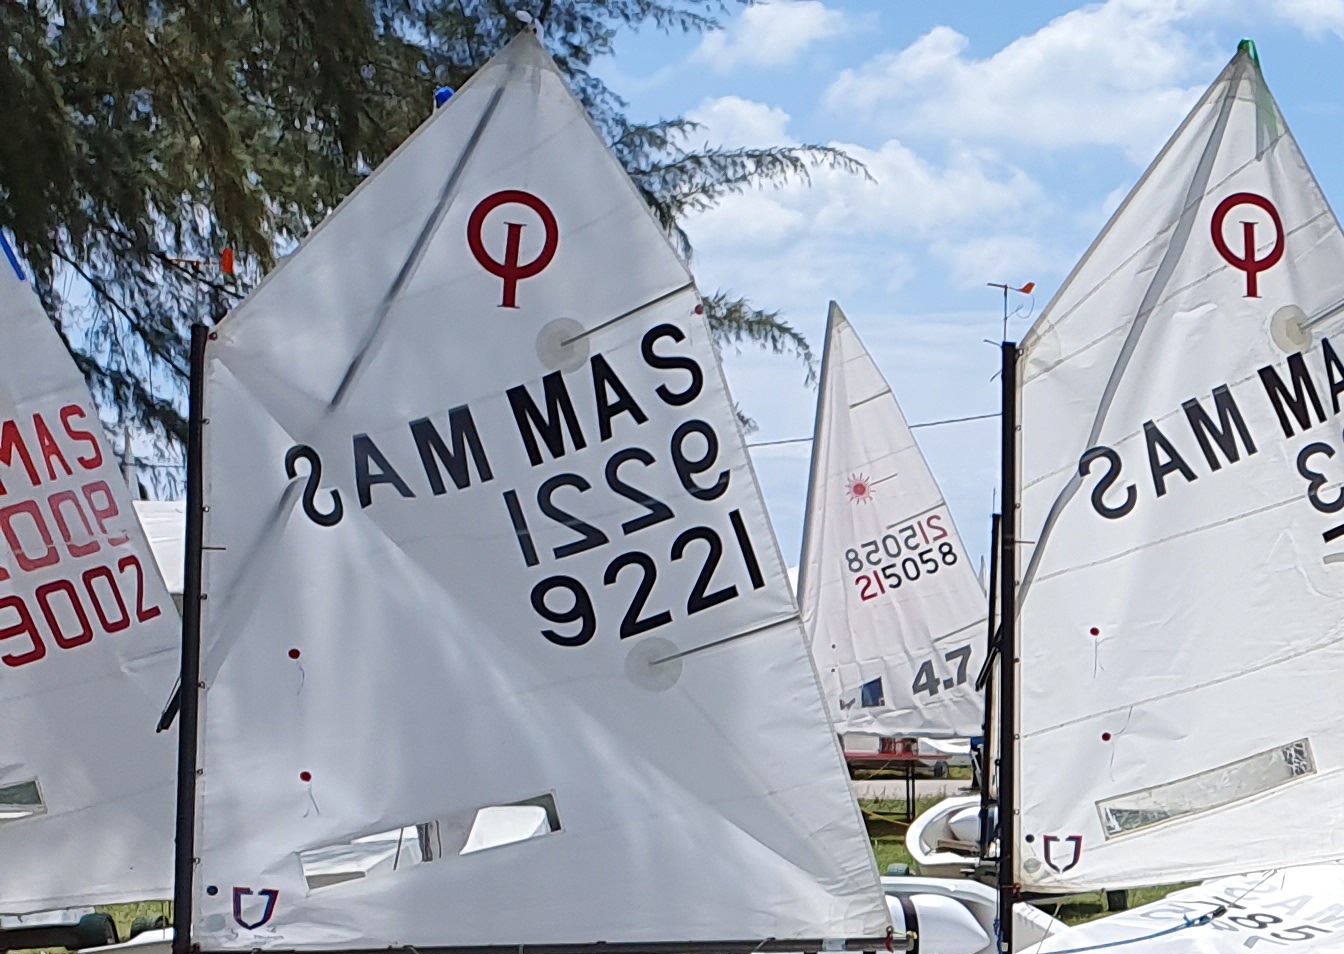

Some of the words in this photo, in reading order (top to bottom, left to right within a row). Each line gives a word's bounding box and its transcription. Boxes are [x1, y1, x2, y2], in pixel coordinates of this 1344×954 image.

[506, 323, 704, 467] MAS
[0, 404, 103, 496] MAS
[0, 555, 162, 667] 9002
[529, 511, 764, 647] 9221
[855, 541, 958, 601] 215058
[911, 644, 972, 697] 4.7
